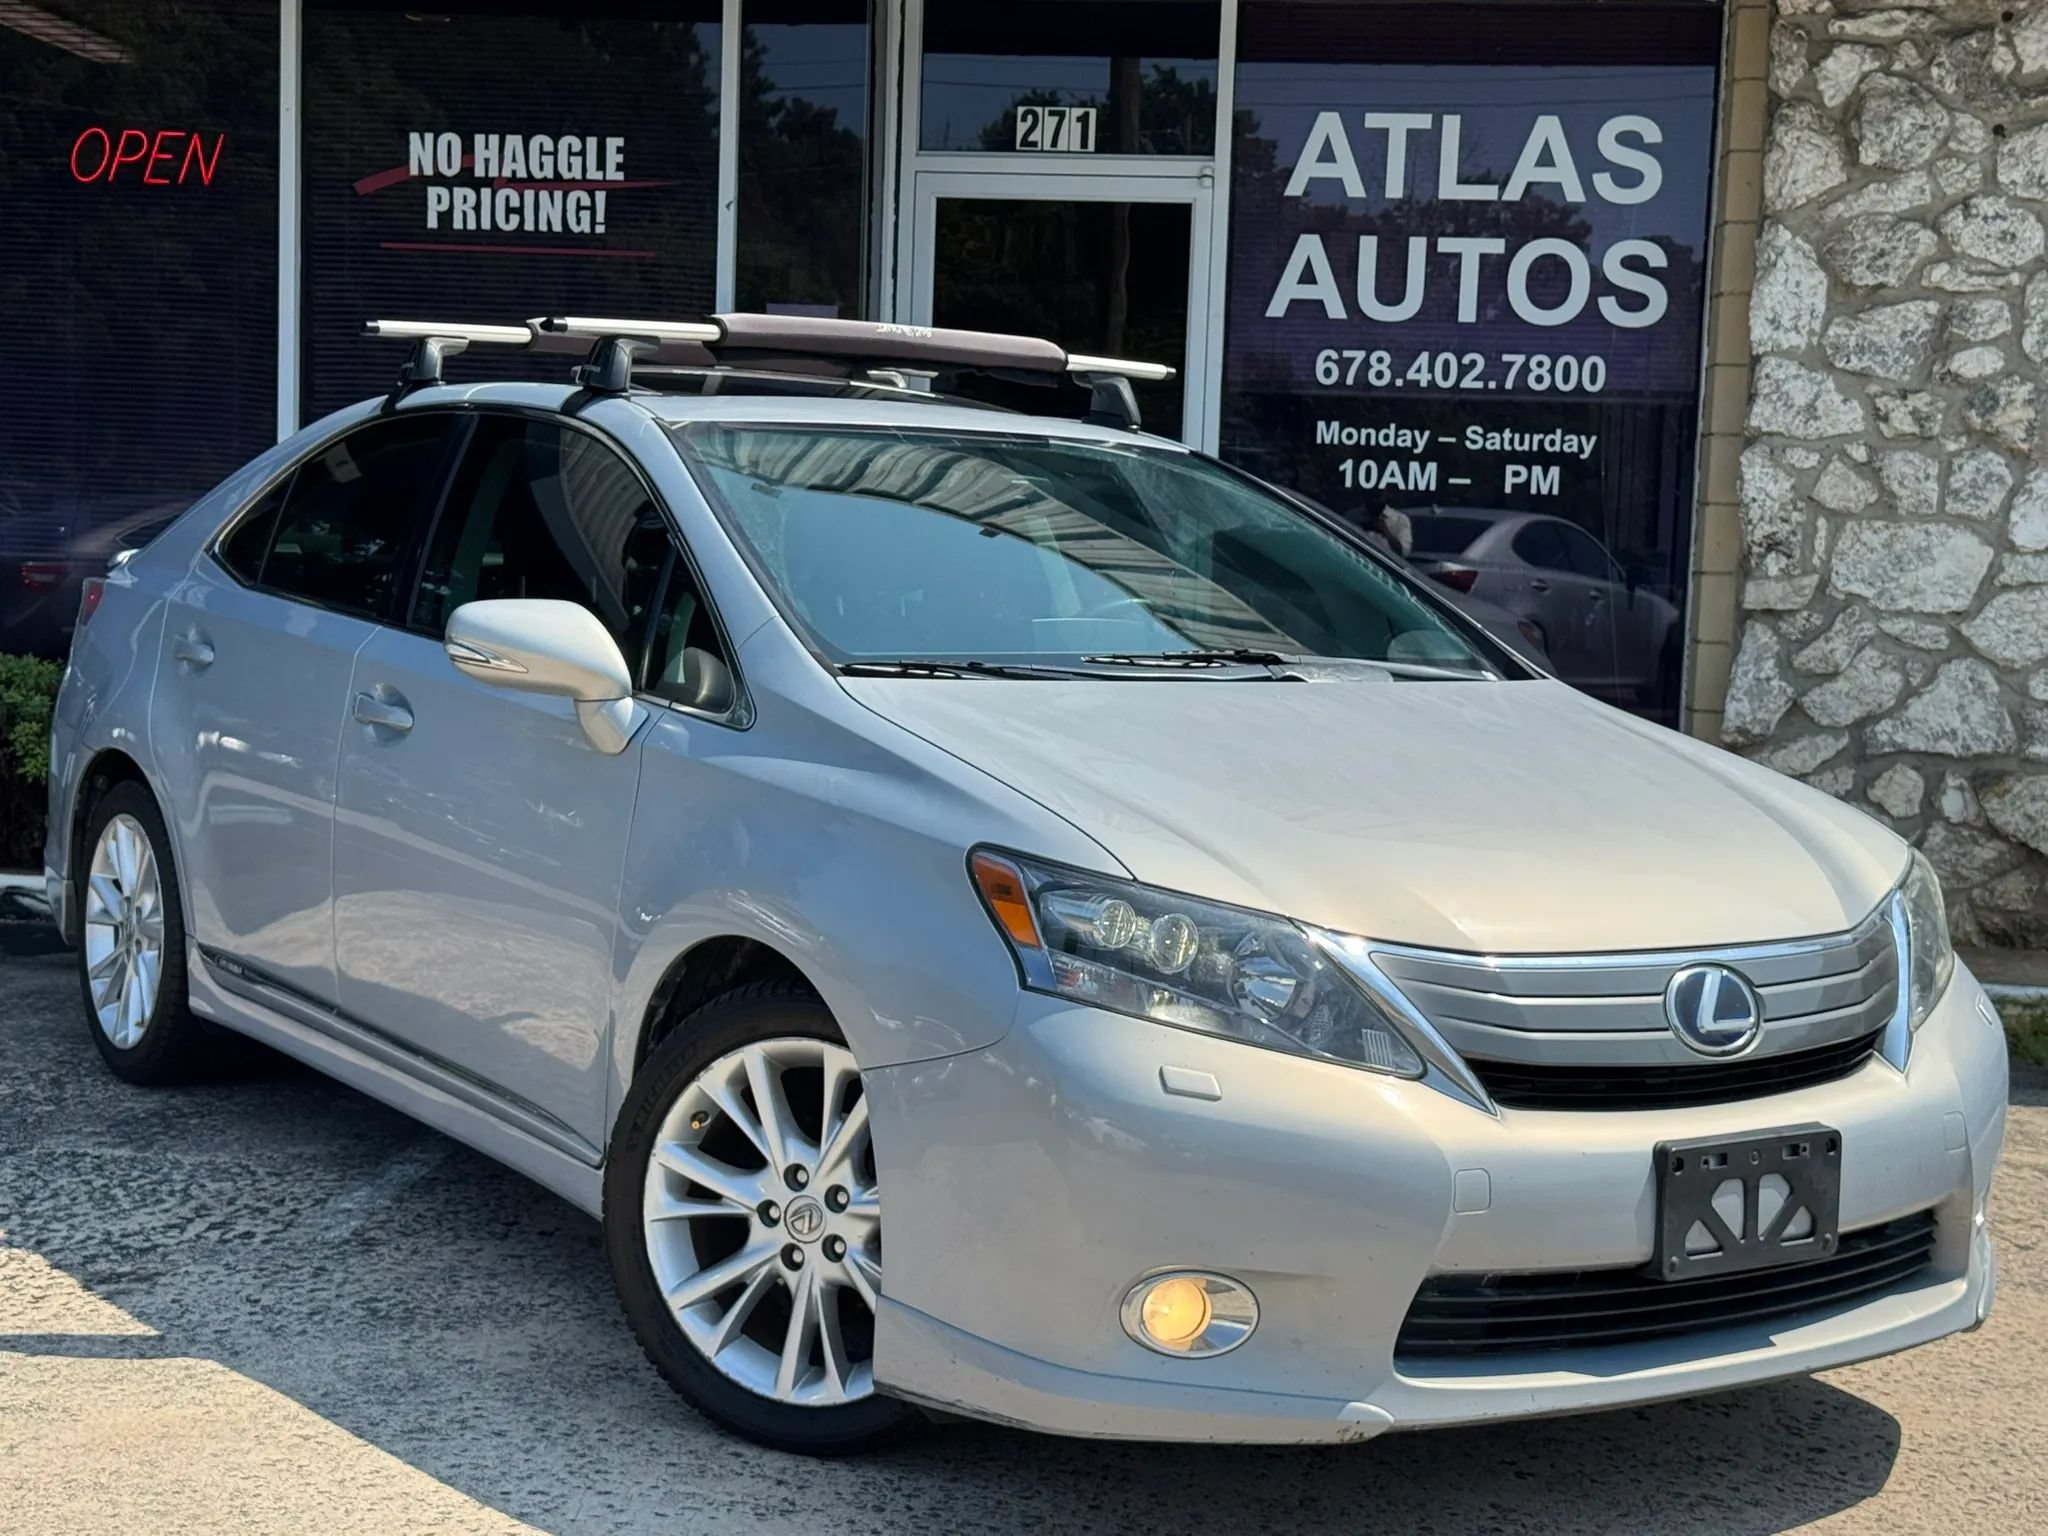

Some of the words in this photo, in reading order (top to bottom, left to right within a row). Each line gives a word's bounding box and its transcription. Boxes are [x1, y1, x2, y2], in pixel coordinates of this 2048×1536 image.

[1018, 108, 1092, 149] 271
[70, 127, 223, 185] OPEN
[409, 132, 462, 177] NO
[474, 133, 625, 181] HAGGLE
[1283, 111, 1663, 205] ATLAS
[427, 186, 607, 234] PRICING!
[1266, 234, 1669, 328] AUTOS
[1315, 349, 1606, 393] 678.402.7800
[1316, 420, 1430, 454] Monday
[1465, 425, 1597, 459] Saturday
[1339, 458, 1437, 491] 10AM
[1504, 464, 1560, 495] PM
